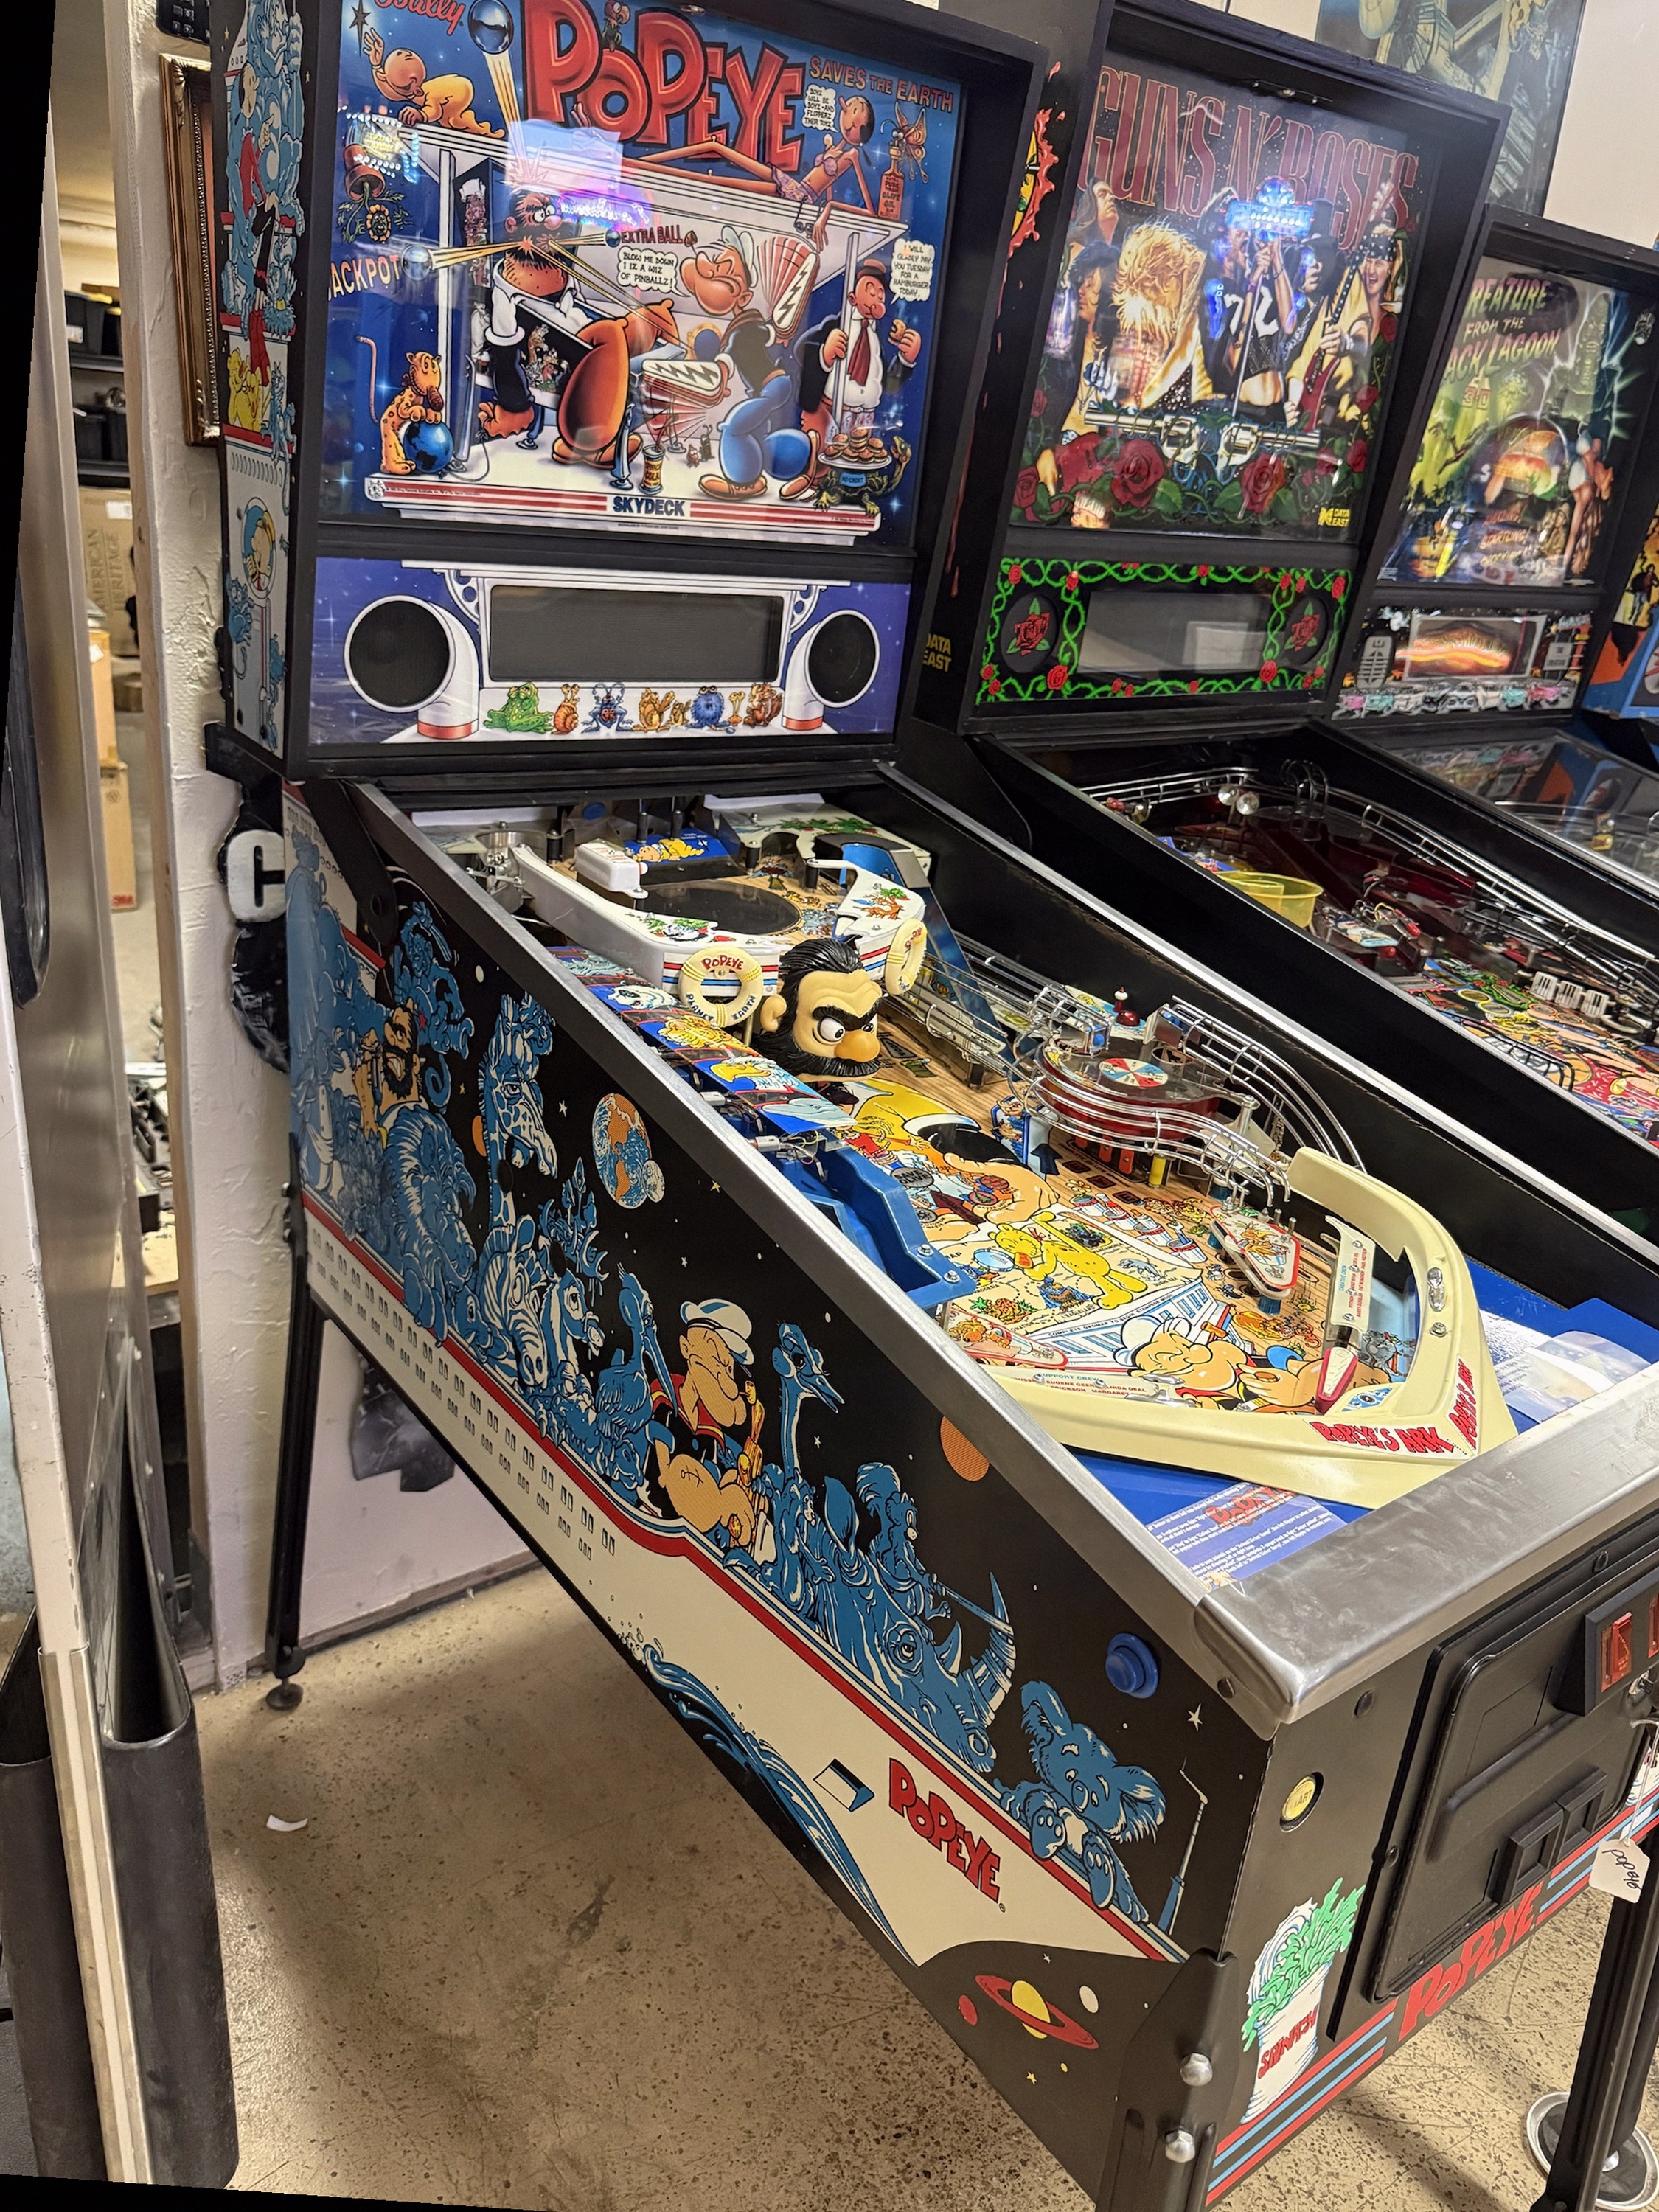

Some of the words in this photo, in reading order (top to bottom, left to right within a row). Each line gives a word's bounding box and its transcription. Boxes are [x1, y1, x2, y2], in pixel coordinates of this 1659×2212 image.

[520, 0, 806, 174] POPEYE
[809, 55, 866, 90] SAVES
[869, 75, 894, 94] THE
[896, 79, 954, 114] EARTH
[807, 102, 821, 110] BOYZ
[807, 110, 832, 119] FLIPPERZ
[1077, 66, 1225, 218] GUNS
[1278, 119, 1419, 251] ROSES
[882, 192, 900, 201] OLIVE
[883, 199, 895, 208] OIL
[621, 227, 656, 244] EXTRA
[657, 224, 684, 244] BALL
[623, 251, 641, 261] BLOW
[644, 255, 653, 263] ME
[655, 257, 675, 266] DOWN
[623, 262, 626, 270] I
[640, 264, 646, 272] A
[648, 266, 663, 274] WIZ
[894, 262, 905, 270] YOU
[907, 263, 931, 274] TUESDAY
[897, 253, 919, 262] GLADLY
[921, 256, 931, 264] PAY
[327, 254, 400, 301] ACKPOT
[620, 272, 630, 280] OF
[893, 279, 928, 289] HAMBURGER
[1465, 277, 1551, 318] REATURE
[1463, 319, 1499, 342] FROM
[1502, 316, 1526, 333] THE
[1443, 339, 1489, 383] ACK
[1484, 327, 1562, 375] LAGOON
[1461, 385, 1492, 410] 3-D
[613, 495, 686, 517] SKYDECK
[1334, 509, 1350, 517] DATA
[1332, 518, 1349, 527] EAST
[86, 529, 105, 610] MERICAN
[105, 532, 126, 611] HERITAGE
[700, 954, 744, 970] POPEYE
[686, 993, 714, 1022] PLANET
[731, 995, 756, 1020] EARTH
[894, 1169, 923, 1180] SAVE
[899, 1173, 930, 1186] OLIVE
[1048, 1327, 1081, 1337] COMPLETE
[1120, 1312, 1135, 1321] BEGIN
[1136, 1299, 1161, 1313] STAMPEDE
[1458, 1358, 1475, 1395] ARK
[1448, 1382, 1477, 1450] POPEYE'S
[1309, 1422, 1400, 1451] POPEYE'S
[1394, 1427, 1455, 1453] ARK
[888, 1757, 1001, 1904] POPEYE
[1397, 1880, 1543, 2042] POPEYE
[1258, 2002, 1320, 2079] SPINACH
